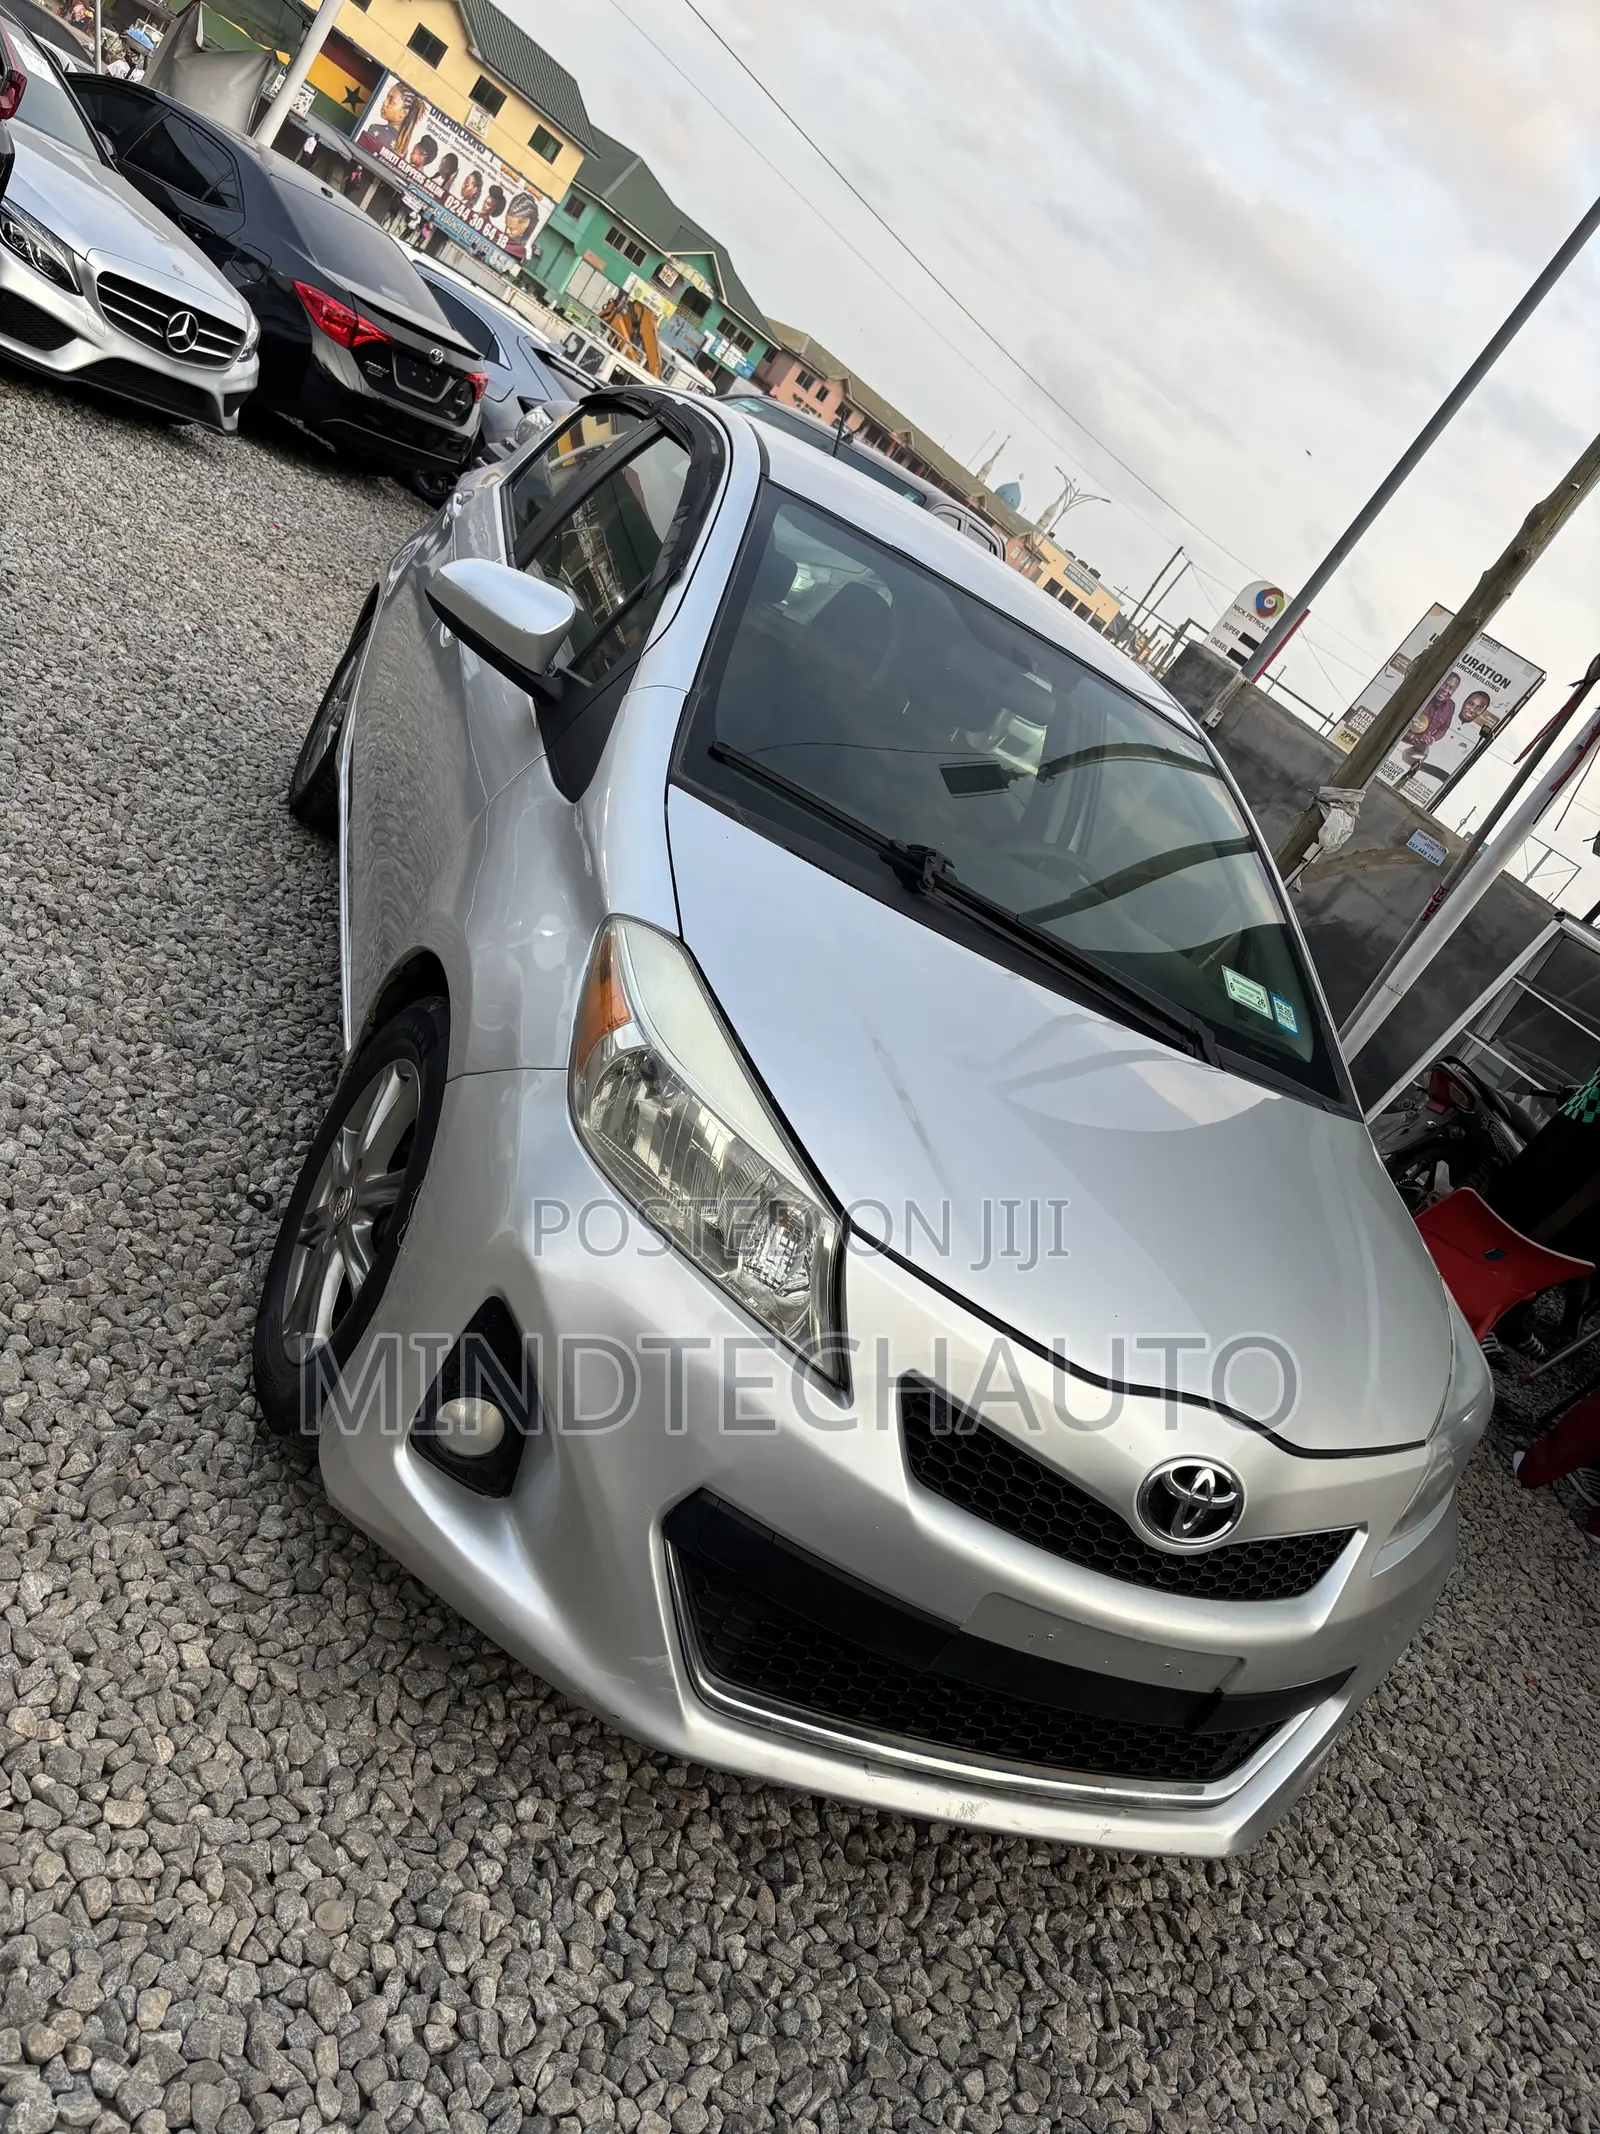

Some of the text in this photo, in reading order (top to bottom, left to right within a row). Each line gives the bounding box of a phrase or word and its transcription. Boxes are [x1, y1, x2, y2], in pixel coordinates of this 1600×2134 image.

[379, 146, 400, 164] MULTI
[397, 160, 426, 185] CLIPPERS
[424, 177, 445, 198] SALON
[443, 195, 472, 222] 0244
[468, 212, 484, 231] 30
[482, 222, 498, 241] 64
[496, 233, 510, 250] 18
[1232, 603, 1271, 633] NICK PETROLE
[1222, 621, 1241, 638] SUPER
[1210, 636, 1229, 653] DIESEL
[1472, 672, 1501, 693] BUILDING
[1353, 714, 1372, 729] JUNE
[1357, 708, 1375, 722] 14TH
[1340, 730, 1358, 744] 2PM
[1429, 839, 1440, 848] YOUR
